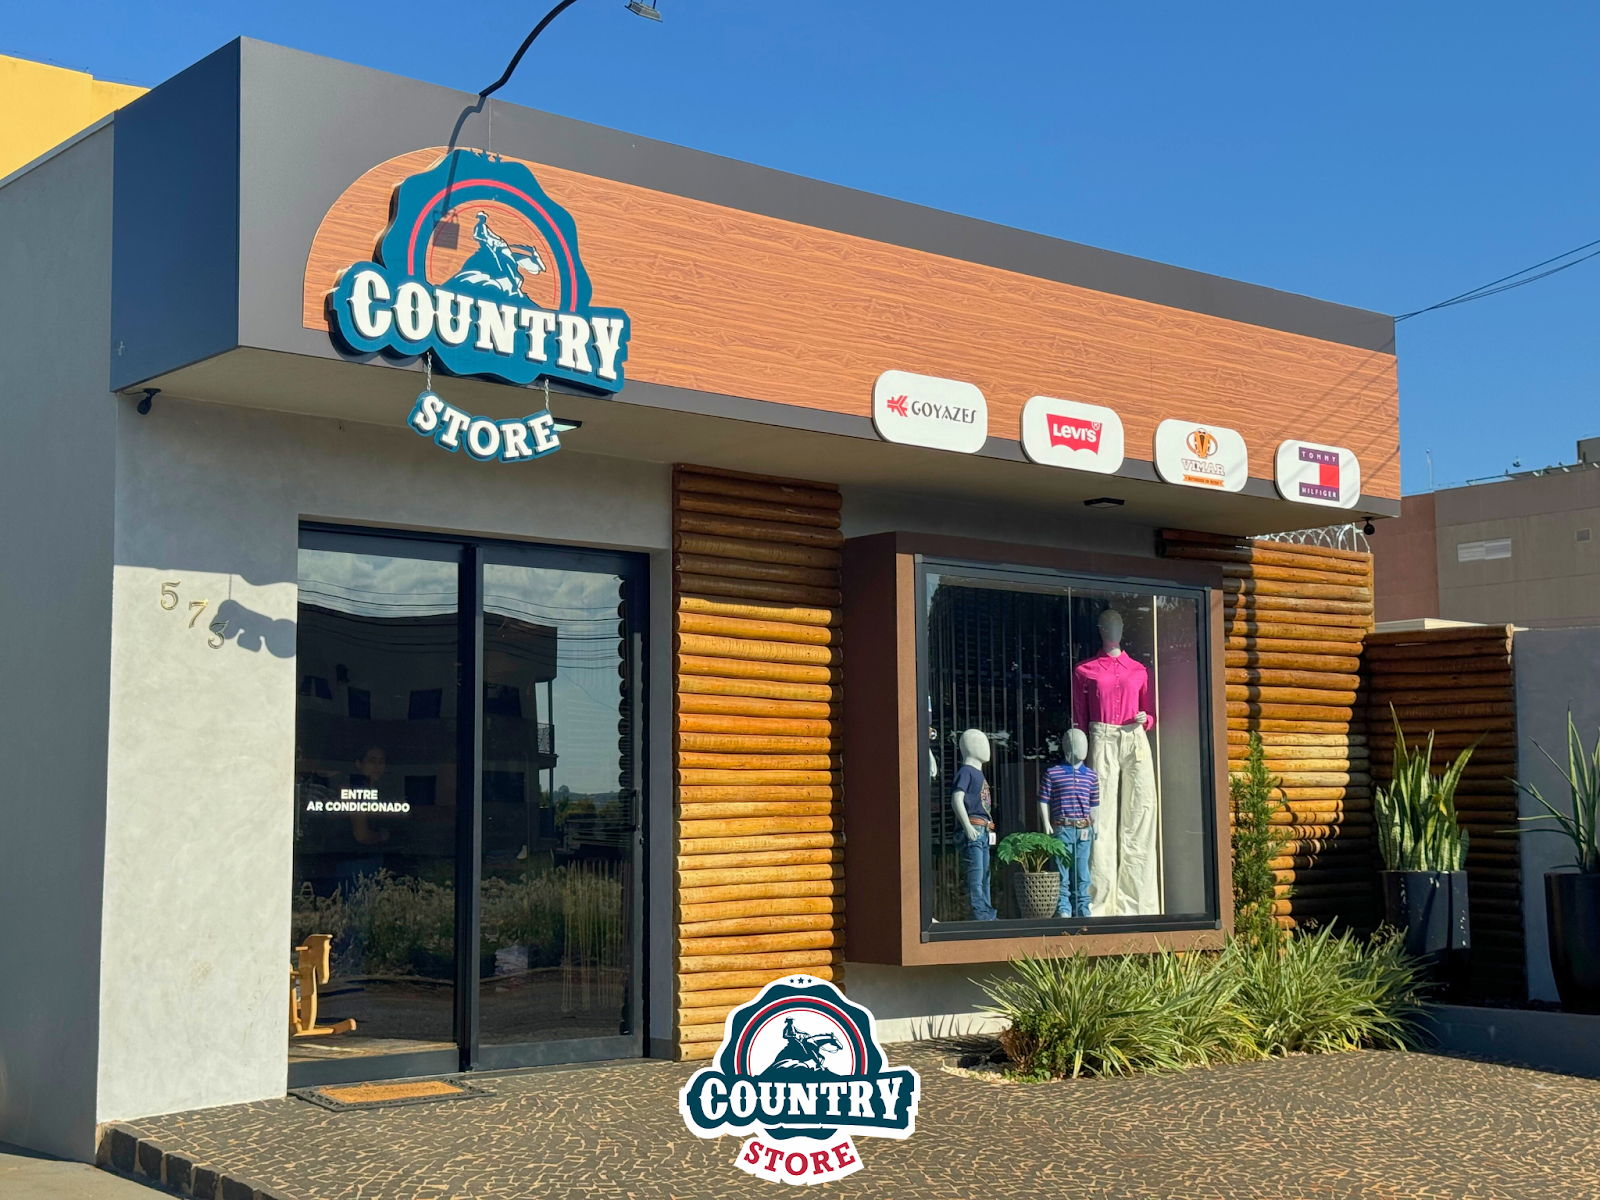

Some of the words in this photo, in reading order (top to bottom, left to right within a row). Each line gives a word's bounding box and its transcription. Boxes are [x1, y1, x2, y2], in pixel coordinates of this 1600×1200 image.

[346, 270, 623, 380] COUNTRY
[911, 400, 977, 424] GOYAZES
[414, 395, 560, 459] STORE
[1301, 451, 1336, 462] TOMMY
[1181, 458, 1225, 476] VIMAR
[1301, 487, 1337, 498] HILFIGER
[341, 789, 378, 800] ENTRE
[306, 801, 323, 812] AR
[325, 801, 410, 812] CONDICIONADO
